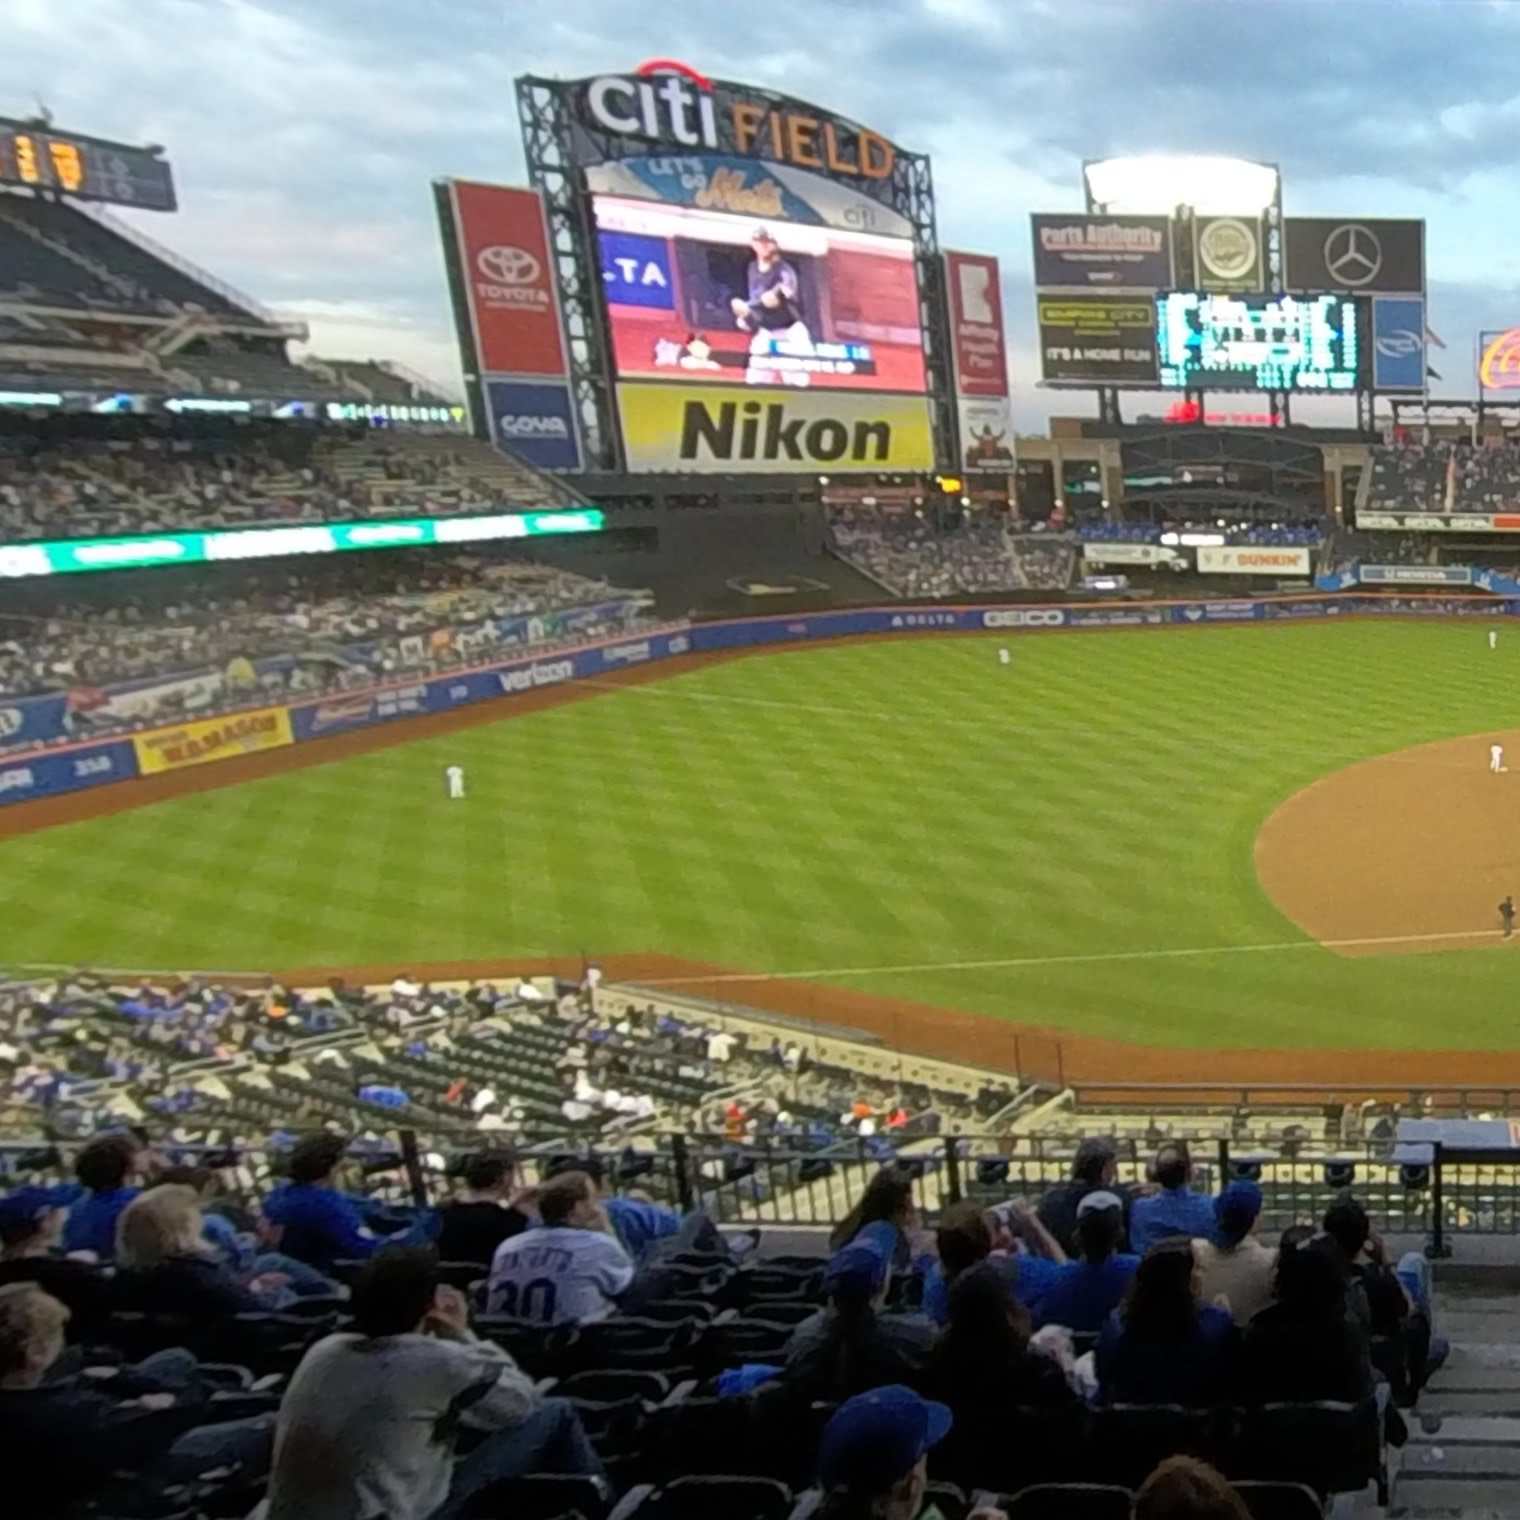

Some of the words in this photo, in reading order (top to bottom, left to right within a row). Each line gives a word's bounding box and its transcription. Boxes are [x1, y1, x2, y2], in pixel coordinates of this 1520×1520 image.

[588, 76, 718, 148] citi
[731, 102, 897, 180] FIELD
[602, 257, 667, 288] TA
[475, 283, 550, 304] TOYOTA
[1073, 348, 1083, 361] A
[680, 400, 891, 461] Nikon
[905, 613, 955, 626] DELTA
[983, 610, 1065, 628] GEICO
[499, 660, 574, 692] verizon
